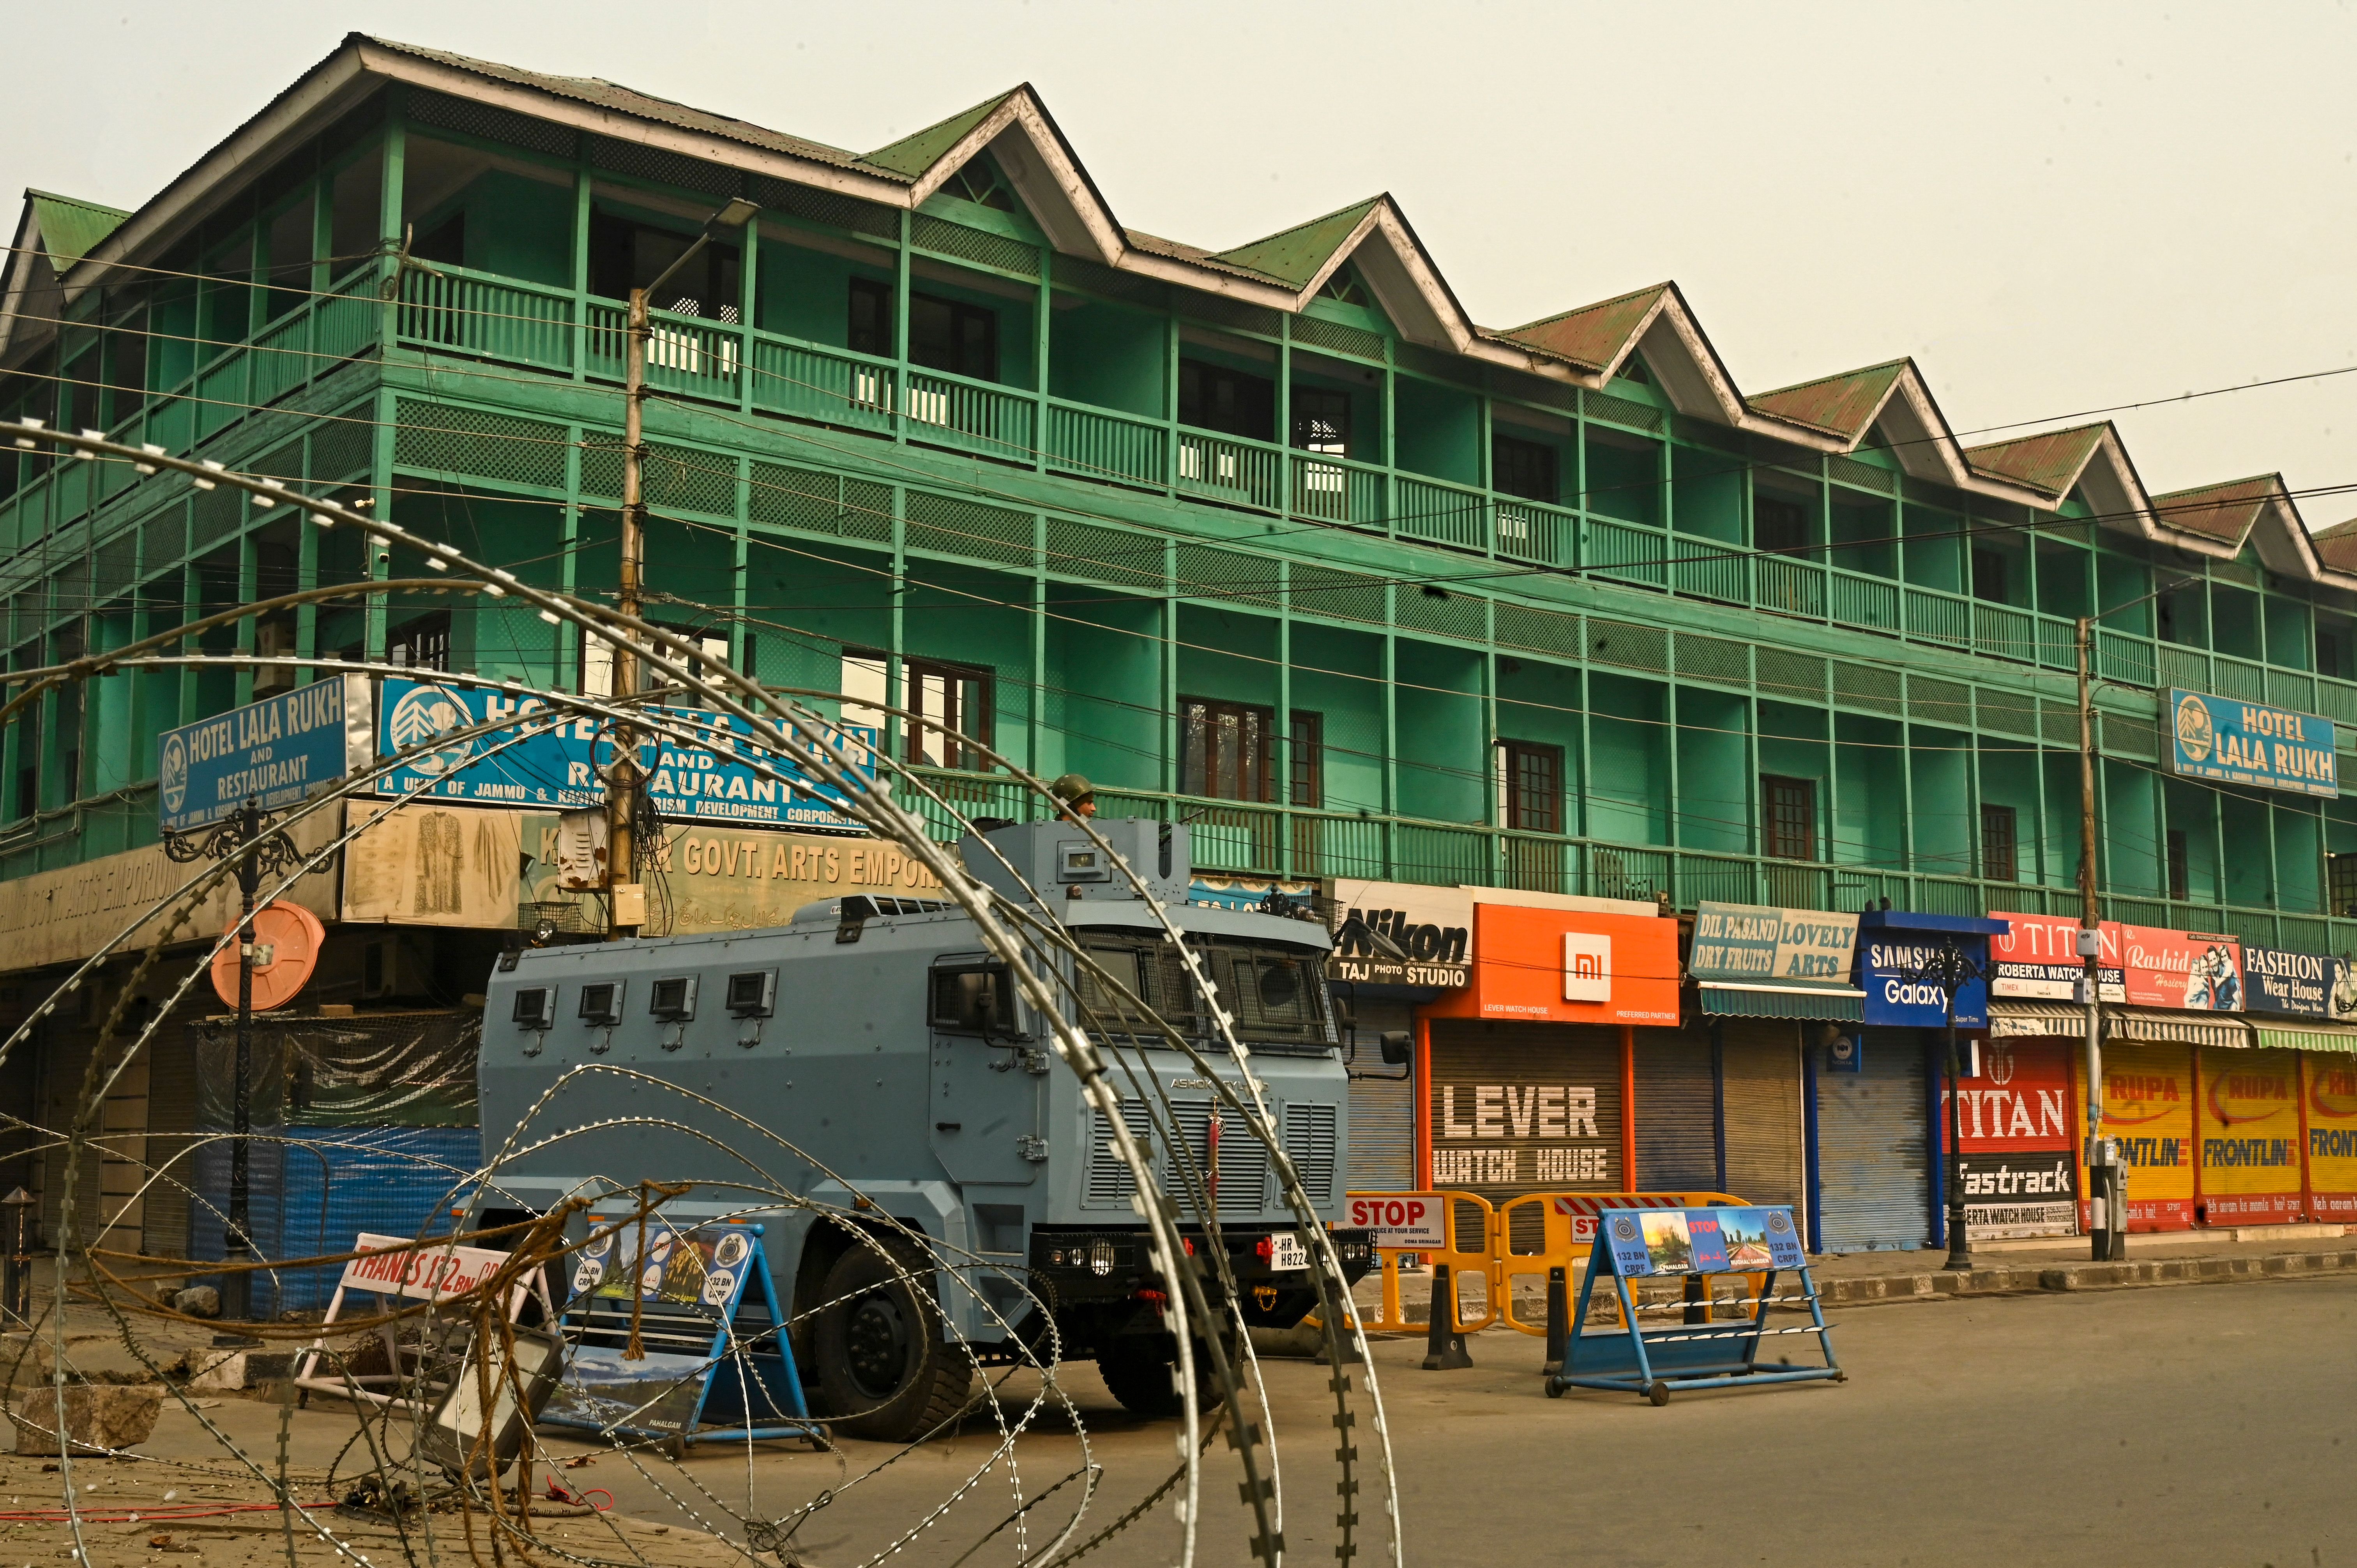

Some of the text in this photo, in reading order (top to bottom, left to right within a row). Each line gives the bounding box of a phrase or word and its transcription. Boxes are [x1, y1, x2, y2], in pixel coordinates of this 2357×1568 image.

[190, 681, 341, 764] HOTEL LALA RUKH
[2242, 706, 2305, 742] HOTEL
[251, 747, 272, 765] AND
[659, 752, 713, 770] AND
[2216, 733, 2333, 782] LALA RUKH
[218, 755, 308, 800] RESTAURANT
[568, 761, 793, 803] REAURANT
[383, 775, 394, 790] A
[447, 780, 465, 795] OF
[474, 783, 525, 799] JAMMU
[537, 788, 549, 802] &
[696, 801, 779, 819] DEVELOPMENT
[684, 837, 762, 879] GOVT.
[772, 844, 840, 883] ARTS
[1341, 908, 1468, 962] Nikon
[1699, 914, 1778, 942] DIL PASAND
[1780, 922, 1855, 949] LOVELY
[2023, 923, 2117, 960] TITN
[1694, 945, 1773, 971] DRY FRUITS
[1786, 953, 1839, 978] ARTS
[1871, 944, 1961, 971] SAMSU
[2126, 945, 2189, 972] Rashid
[2245, 947, 2323, 982] FASHION
[1339, 962, 1465, 987] TAJ PHOTO STUDIO
[1998, 964, 2046, 979] ROBERTA
[2048, 966, 2083, 981] WATCH
[2154, 974, 2187, 991] Hosiery
[1885, 980, 1948, 1013] Galaxy
[2001, 983, 2019, 991] TIMEX
[2262, 975, 2289, 998] Wear
[2291, 979, 2323, 1001] House
[1505, 1005, 1527, 1013] WATCH
[1617, 1010, 1649, 1019] PREFERRED
[1170, 1079, 1214, 1090] ASHOK
[2109, 1075, 2179, 1102] RUPA
[2228, 1076, 2288, 1100] RUPA
[1443, 1086, 1599, 1138] LEVER
[1941, 1090, 2064, 1138] TITAN
[2203, 1138, 2298, 1167] FRONTLINE
[1433, 1148, 1608, 1183] WATCH HOUSE
[1352, 1201, 1425, 1226] STOP
[1989, 1208, 2019, 1224] WATCH
[2021, 1206, 2045, 1224] HOUSE
[2206, 1199, 2217, 1213] Yeh
[2312, 1196, 2327, 1210] Yeh
[1689, 1221, 1719, 1234] STOP
[1281, 1238, 1292, 1251] HR
[1617, 1251, 1645, 1261] 132 BN
[1770, 1243, 1784, 1251] 132
[352, 1245, 428, 1286] THANKS
[422, 1255, 461, 1291] 132
[453, 1275, 476, 1294] BN
[1625, 1264, 1645, 1273] CRPF
[1777, 1254, 1798, 1263] CRPF
[578, 1278, 591, 1287] CRP
[590, 1267, 600, 1276] BN
[710, 1277, 731, 1286] 132 BN
[649, 1419, 681, 1429] PAHALGAM
